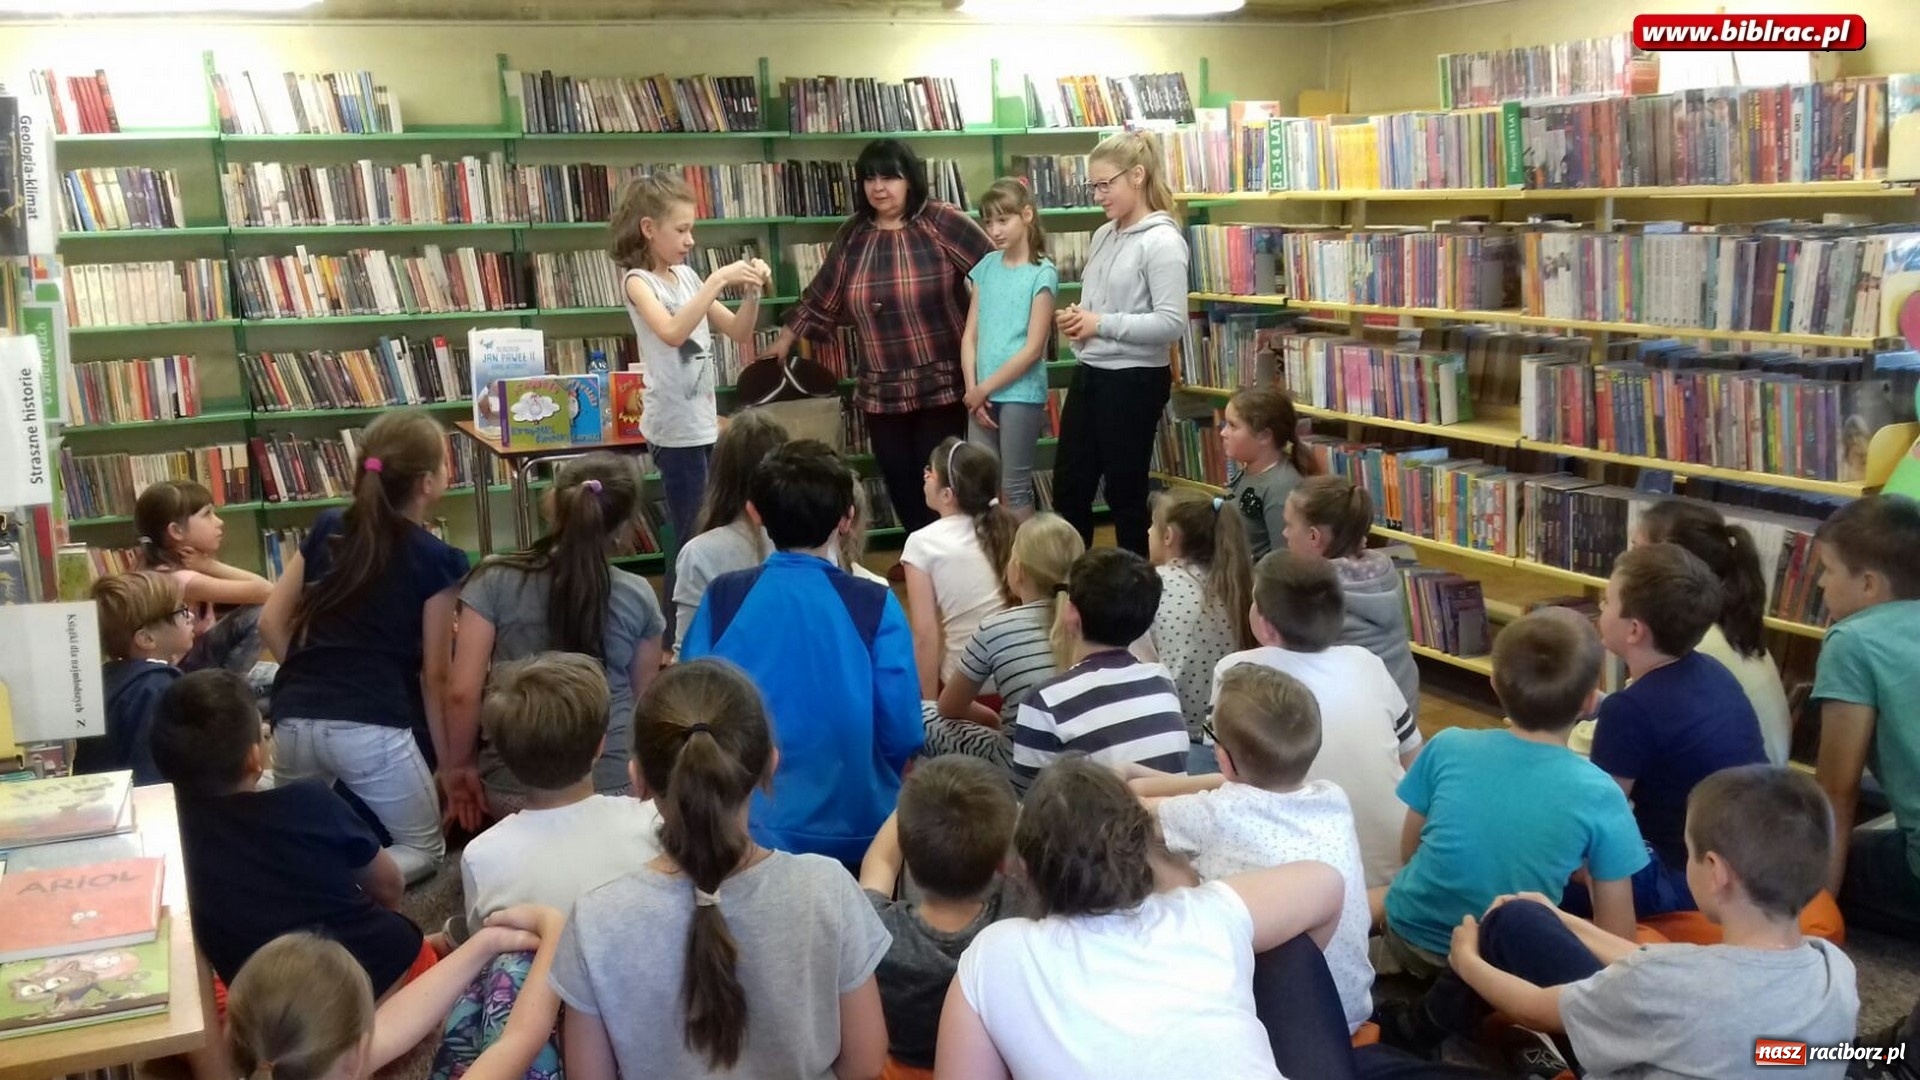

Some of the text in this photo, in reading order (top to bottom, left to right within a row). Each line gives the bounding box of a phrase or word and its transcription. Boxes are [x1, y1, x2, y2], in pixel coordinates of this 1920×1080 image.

[20, 115, 38, 219] Geologia-klimat
[1270, 120, 1282, 187] 12-14 LAT
[20, 367, 44, 485] Straszne historie
[17, 871, 143, 896] ARIOL
